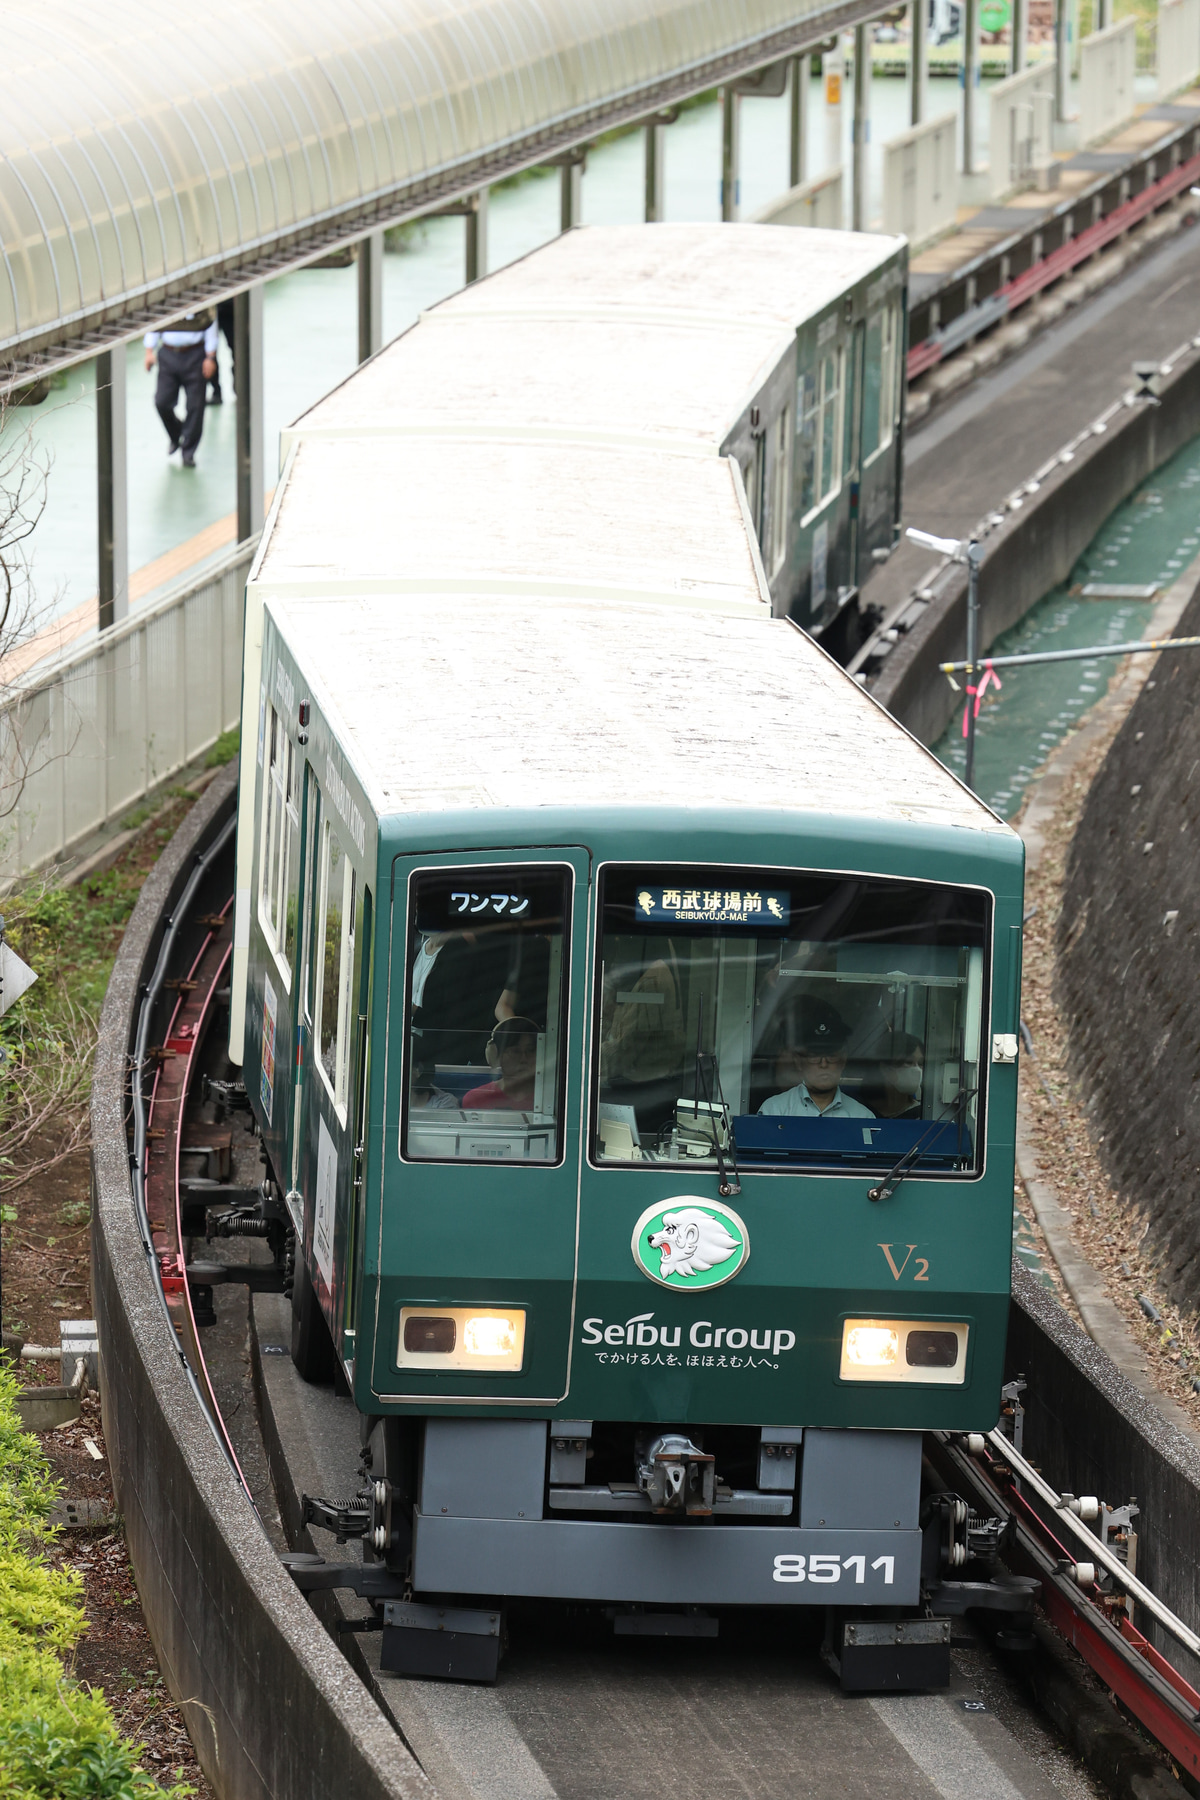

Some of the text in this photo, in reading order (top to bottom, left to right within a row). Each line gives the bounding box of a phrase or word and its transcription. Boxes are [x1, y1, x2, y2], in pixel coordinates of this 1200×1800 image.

[451, 892, 529, 914] ワンマン
[662, 889, 762, 912] 西武球場前
[876, 1243, 930, 1281] V2
[581, 1312, 796, 1356] Seibu Group
[772, 1554, 895, 1584] 8511
